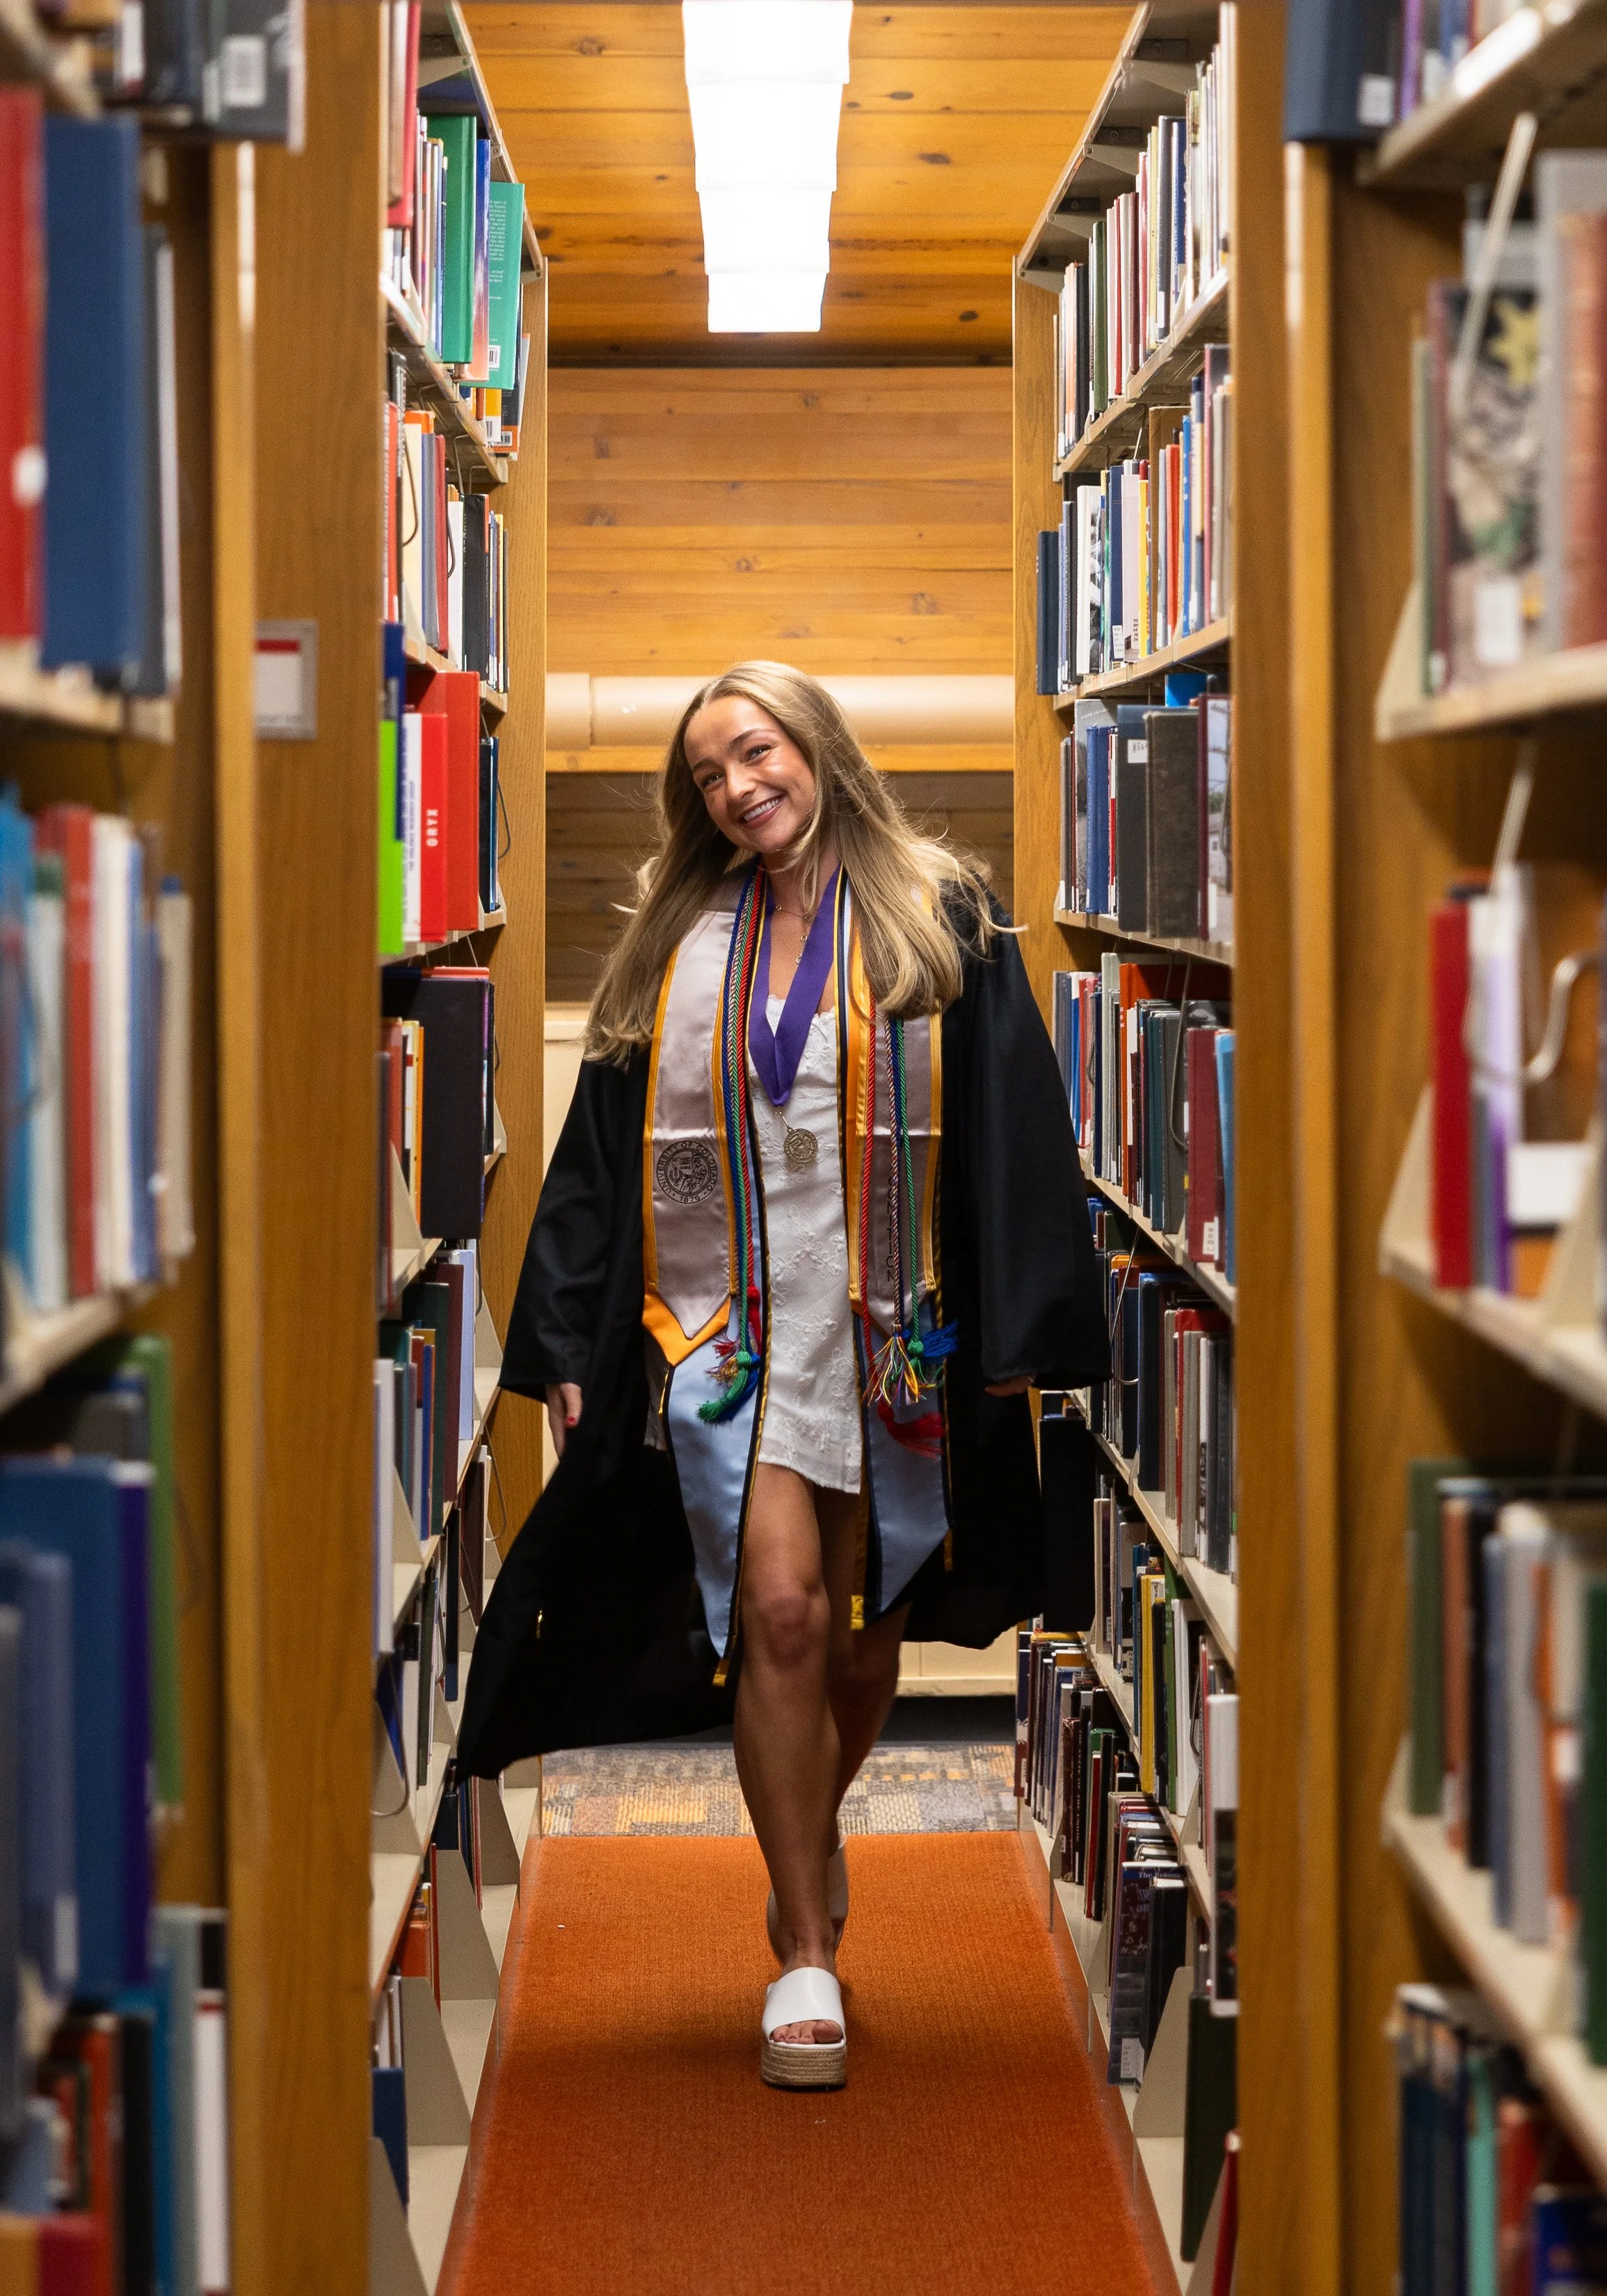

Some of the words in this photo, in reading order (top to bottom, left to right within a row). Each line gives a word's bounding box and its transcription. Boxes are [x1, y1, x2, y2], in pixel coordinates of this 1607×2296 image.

[426, 808, 439, 847] ORYX
[658, 1144, 678, 1194] UNIVERSITY
[696, 1145, 717, 1191] COLORADO
[680, 1195, 701, 1203] 1876
